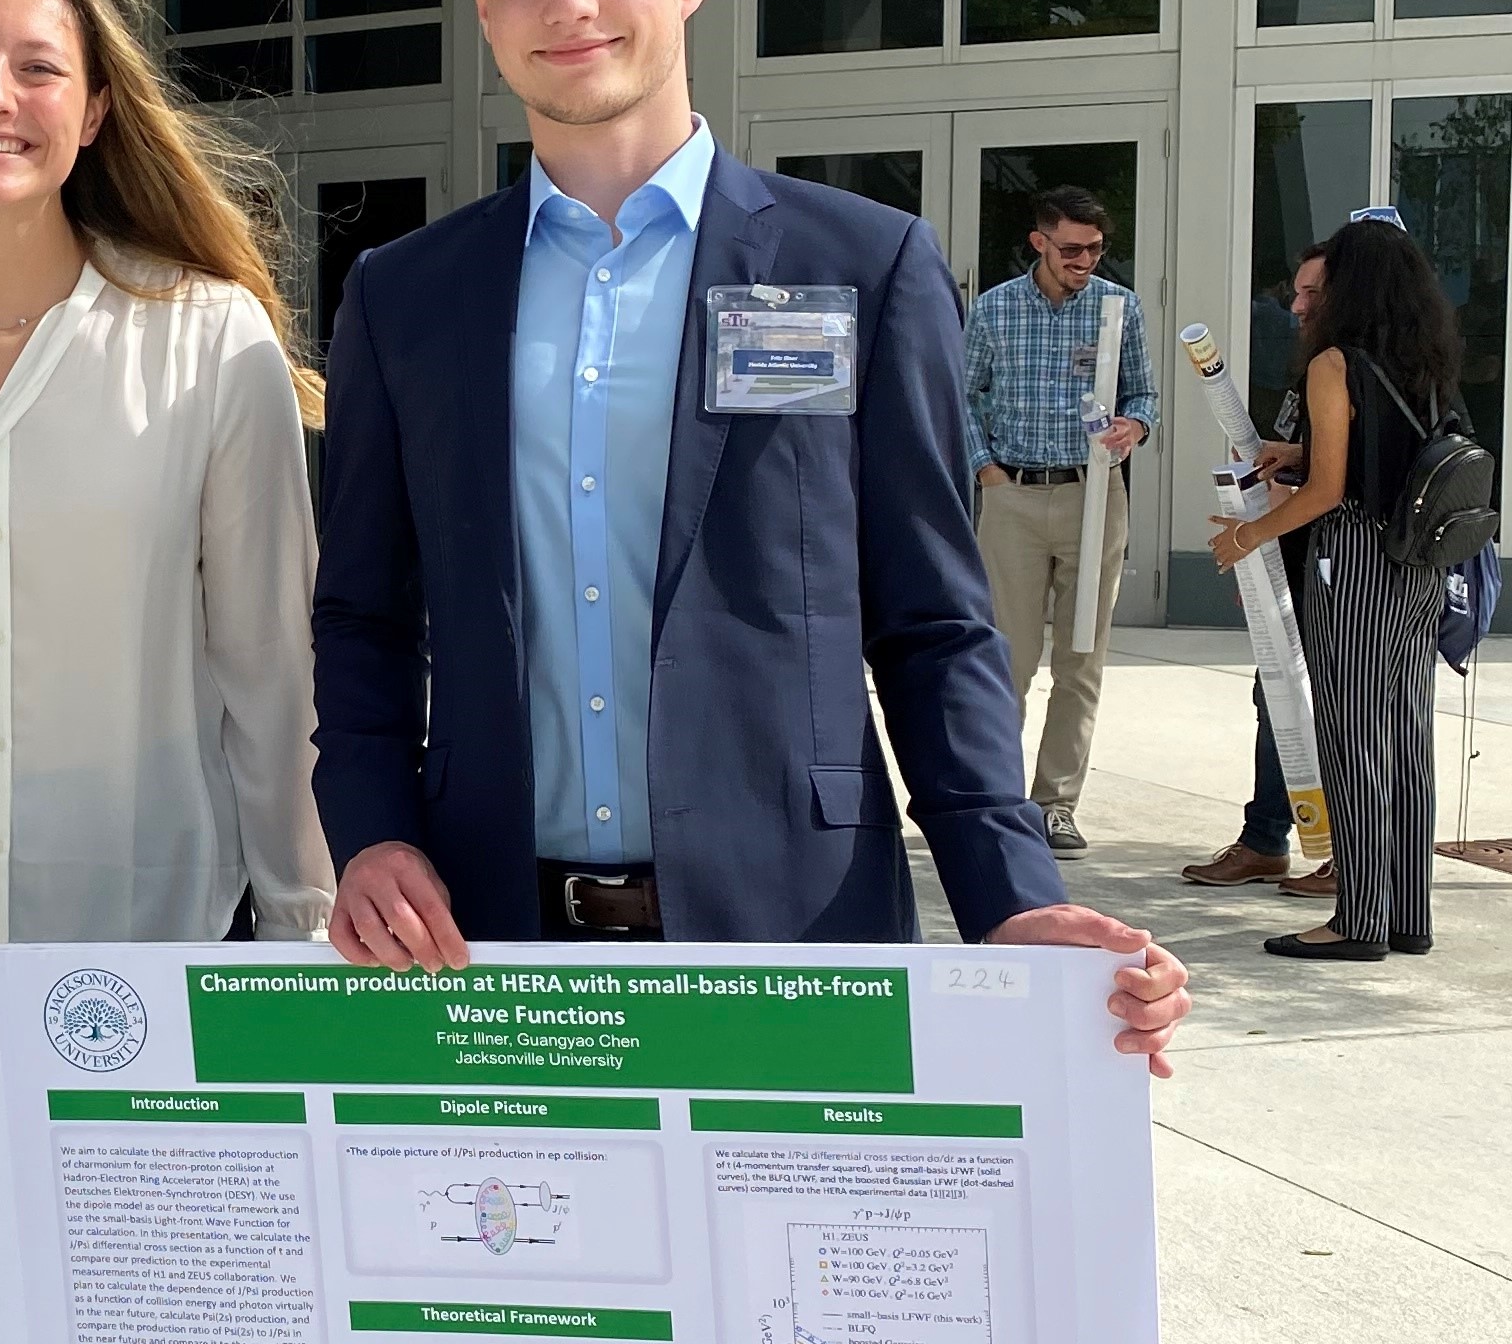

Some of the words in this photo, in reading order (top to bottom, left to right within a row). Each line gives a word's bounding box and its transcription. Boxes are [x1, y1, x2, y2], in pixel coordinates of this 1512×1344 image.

[200, 972, 339, 992] Charmonium
[345, 972, 466, 996] production
[472, 974, 496, 992] at
[501, 973, 564, 993] HERA
[567, 973, 621, 994] with
[627, 973, 758, 995] small-basis
[764, 974, 894, 1000] Light-front
[948, 968, 1015, 990] 224
[49, 973, 140, 1014] JACKSONVILLE
[48, 1016, 59, 1025] 19
[132, 1016, 144, 1025] 34
[445, 1004, 509, 1023] Wave
[515, 1005, 625, 1026] Functions
[436, 1030, 470, 1046] Fritz
[473, 1031, 513, 1047] Illner,
[516, 1032, 595, 1051] Guangyao
[598, 1033, 640, 1048] Chen
[55, 1033, 140, 1068] UNIVERSITY
[455, 1050, 545, 1066] Jacksonville
[548, 1051, 624, 1071] University
[130, 1096, 219, 1111] Introduction
[440, 1099, 490, 1117] Dipole
[493, 1100, 548, 1116] Picture
[823, 1107, 883, 1123] Results
[60, 1146, 76, 1155] We
[77, 1146, 95, 1155] aim
[96, 1147, 108, 1156] to
[109, 1146, 150, 1156] calculate
[151, 1147, 167, 1158] the
[169, 1147, 216, 1158] diffractive
[218, 1148, 299, 1161] photoproduction
[349, 1146, 369, 1157] The
[370, 1146, 402, 1159] dipole
[403, 1146, 439, 1159] picture
[440, 1147, 452, 1157] of
[478, 1148, 533, 1160] production
[535, 1150, 546, 1160] in
[547, 1152, 561, 1162] ep
[420, 1306, 506, 1323] Theoretical
[509, 1310, 597, 1327] Framework
[847, 1323, 877, 1335] BLFQ
